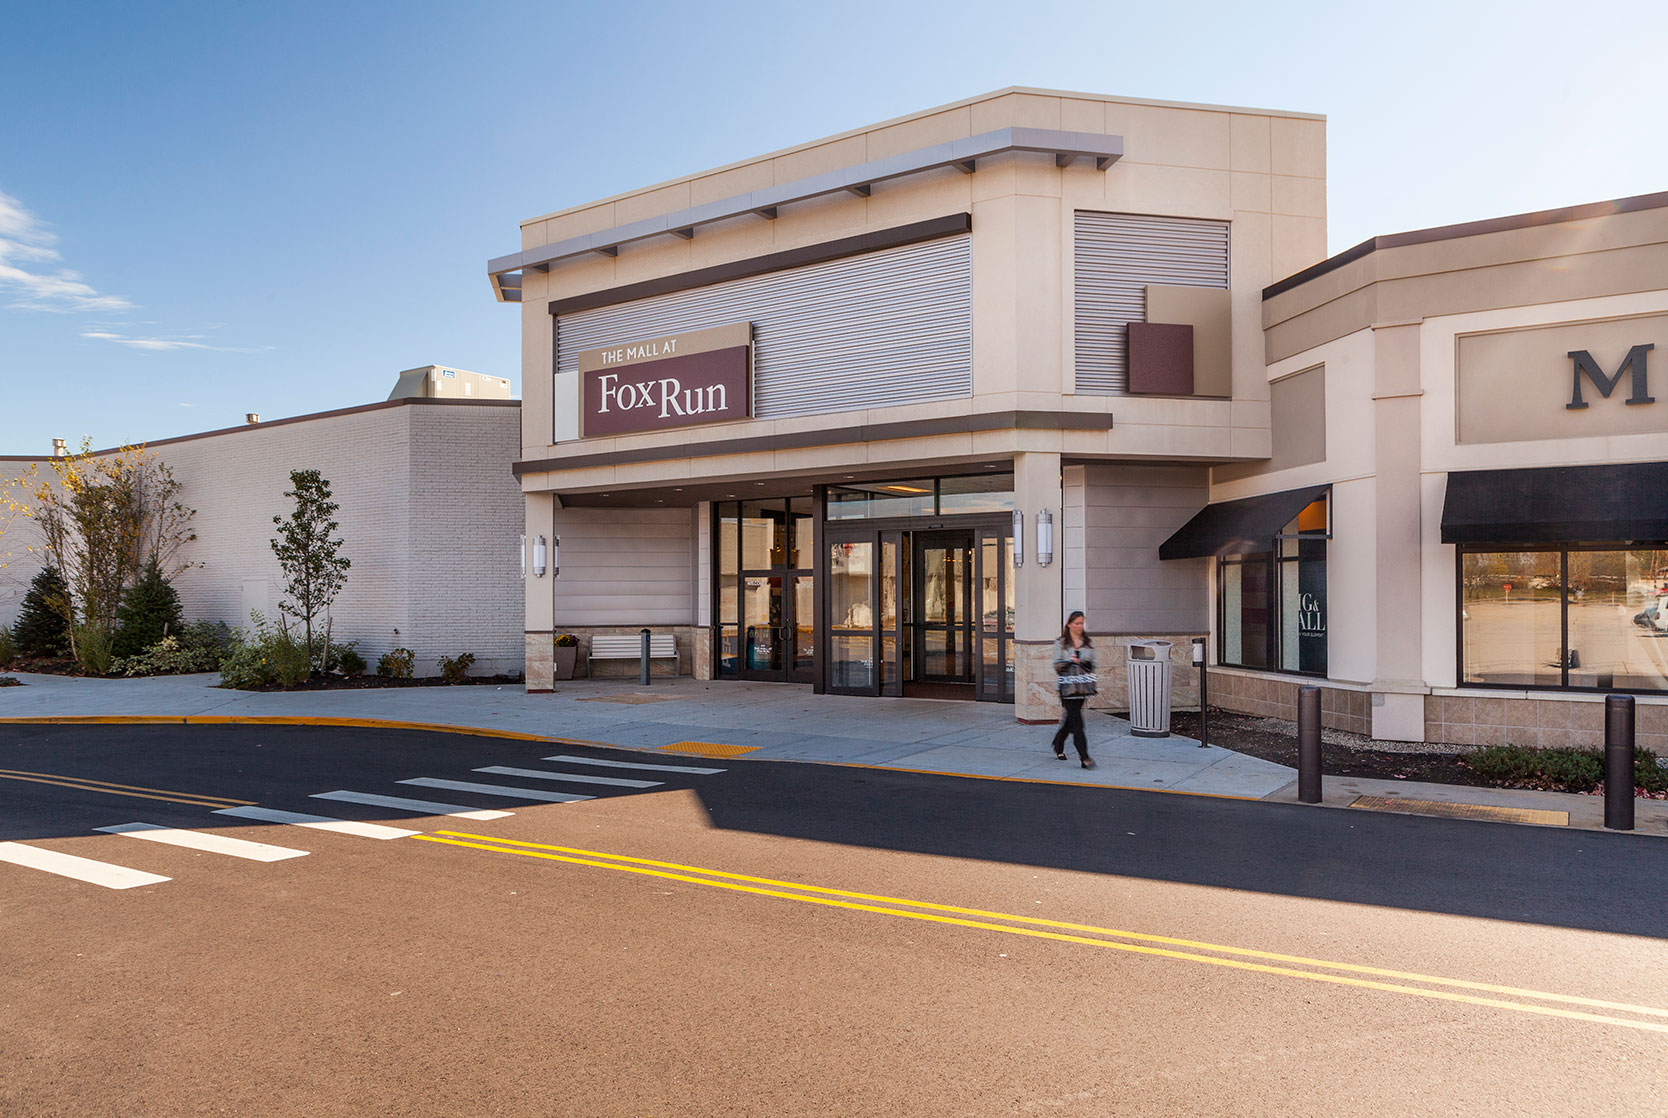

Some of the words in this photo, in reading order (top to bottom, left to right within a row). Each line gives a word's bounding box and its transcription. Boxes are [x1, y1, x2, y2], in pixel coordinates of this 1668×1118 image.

[602, 349, 623, 365] THE
[626, 343, 659, 360] MALL
[662, 339, 677, 354] AT
[1565, 342, 1656, 410] M
[658, 377, 729, 419] Run
